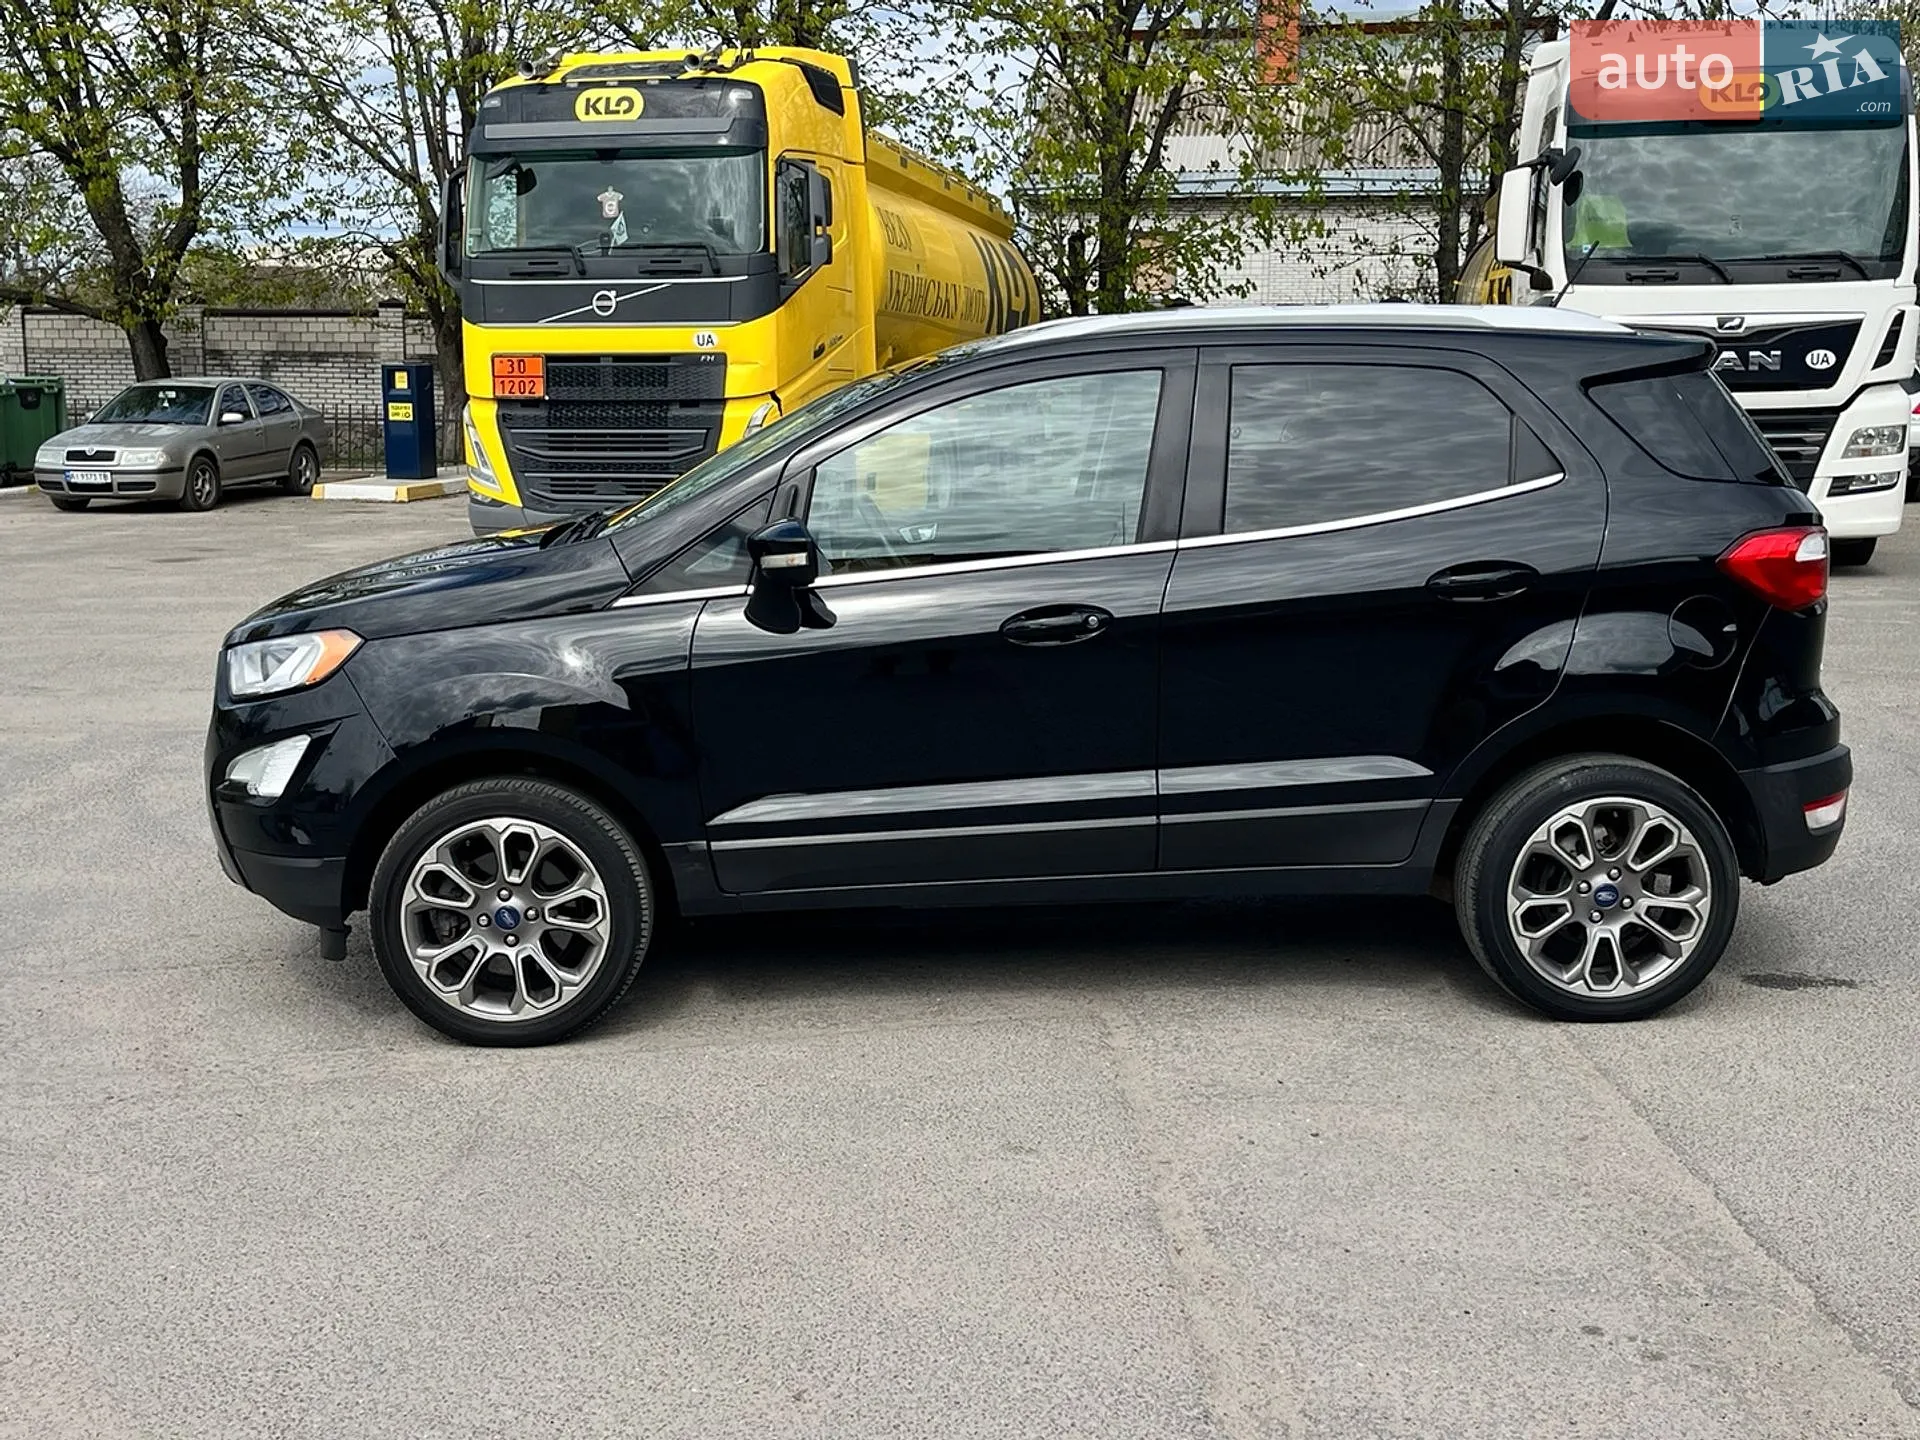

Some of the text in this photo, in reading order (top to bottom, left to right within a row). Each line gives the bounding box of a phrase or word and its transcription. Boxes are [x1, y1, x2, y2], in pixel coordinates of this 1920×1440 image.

[585, 96, 634, 116] KLO
[696, 334, 715, 347] UA
[506, 358, 527, 374] 30
[1711, 350, 1782, 371] AN
[1810, 352, 1830, 366] UA
[499, 379, 536, 395] 1202
